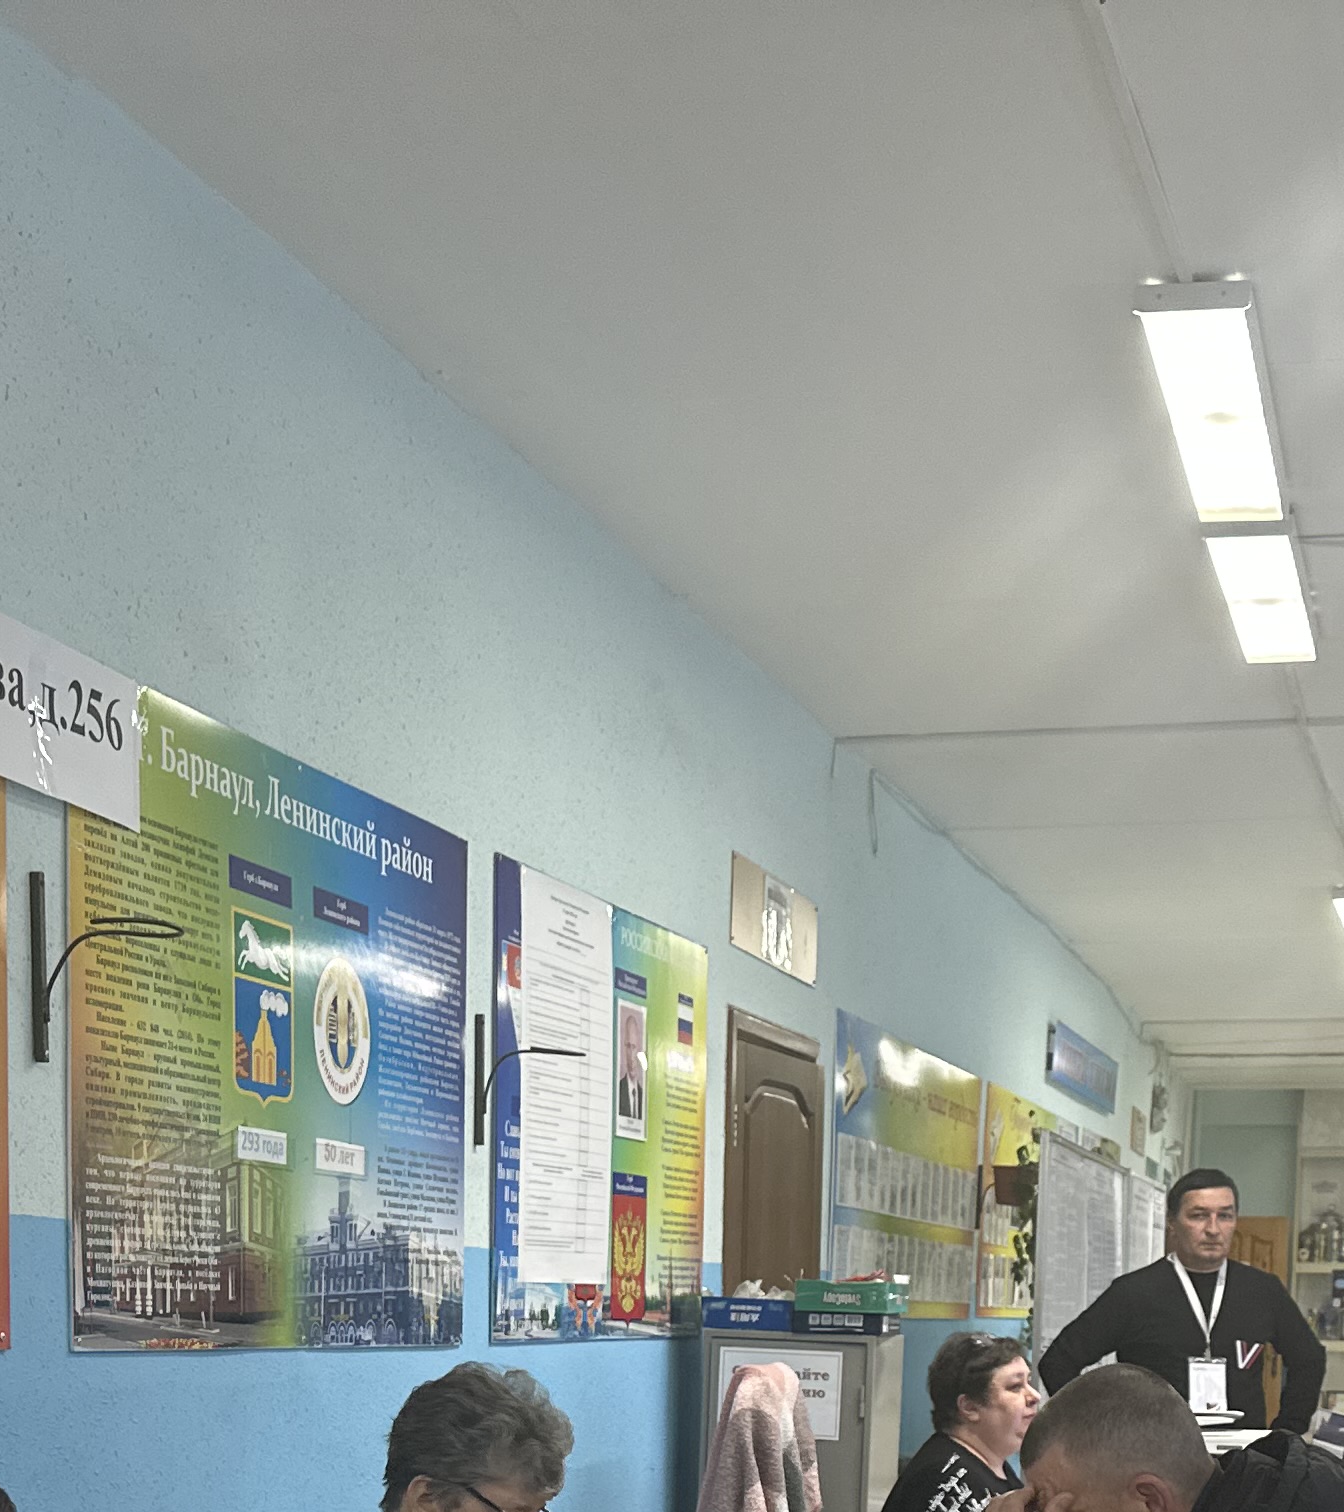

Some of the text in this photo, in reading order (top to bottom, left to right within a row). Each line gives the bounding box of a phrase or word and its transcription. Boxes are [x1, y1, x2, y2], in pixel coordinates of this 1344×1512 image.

[159, 725, 262, 819] Барнаул,
[264, 775, 378, 861] Ленинский
[380, 836, 435, 884] район
[241, 1130, 261, 1153] 293
[262, 1138, 285, 1160] года
[324, 1143, 356, 1167] 50 лет
